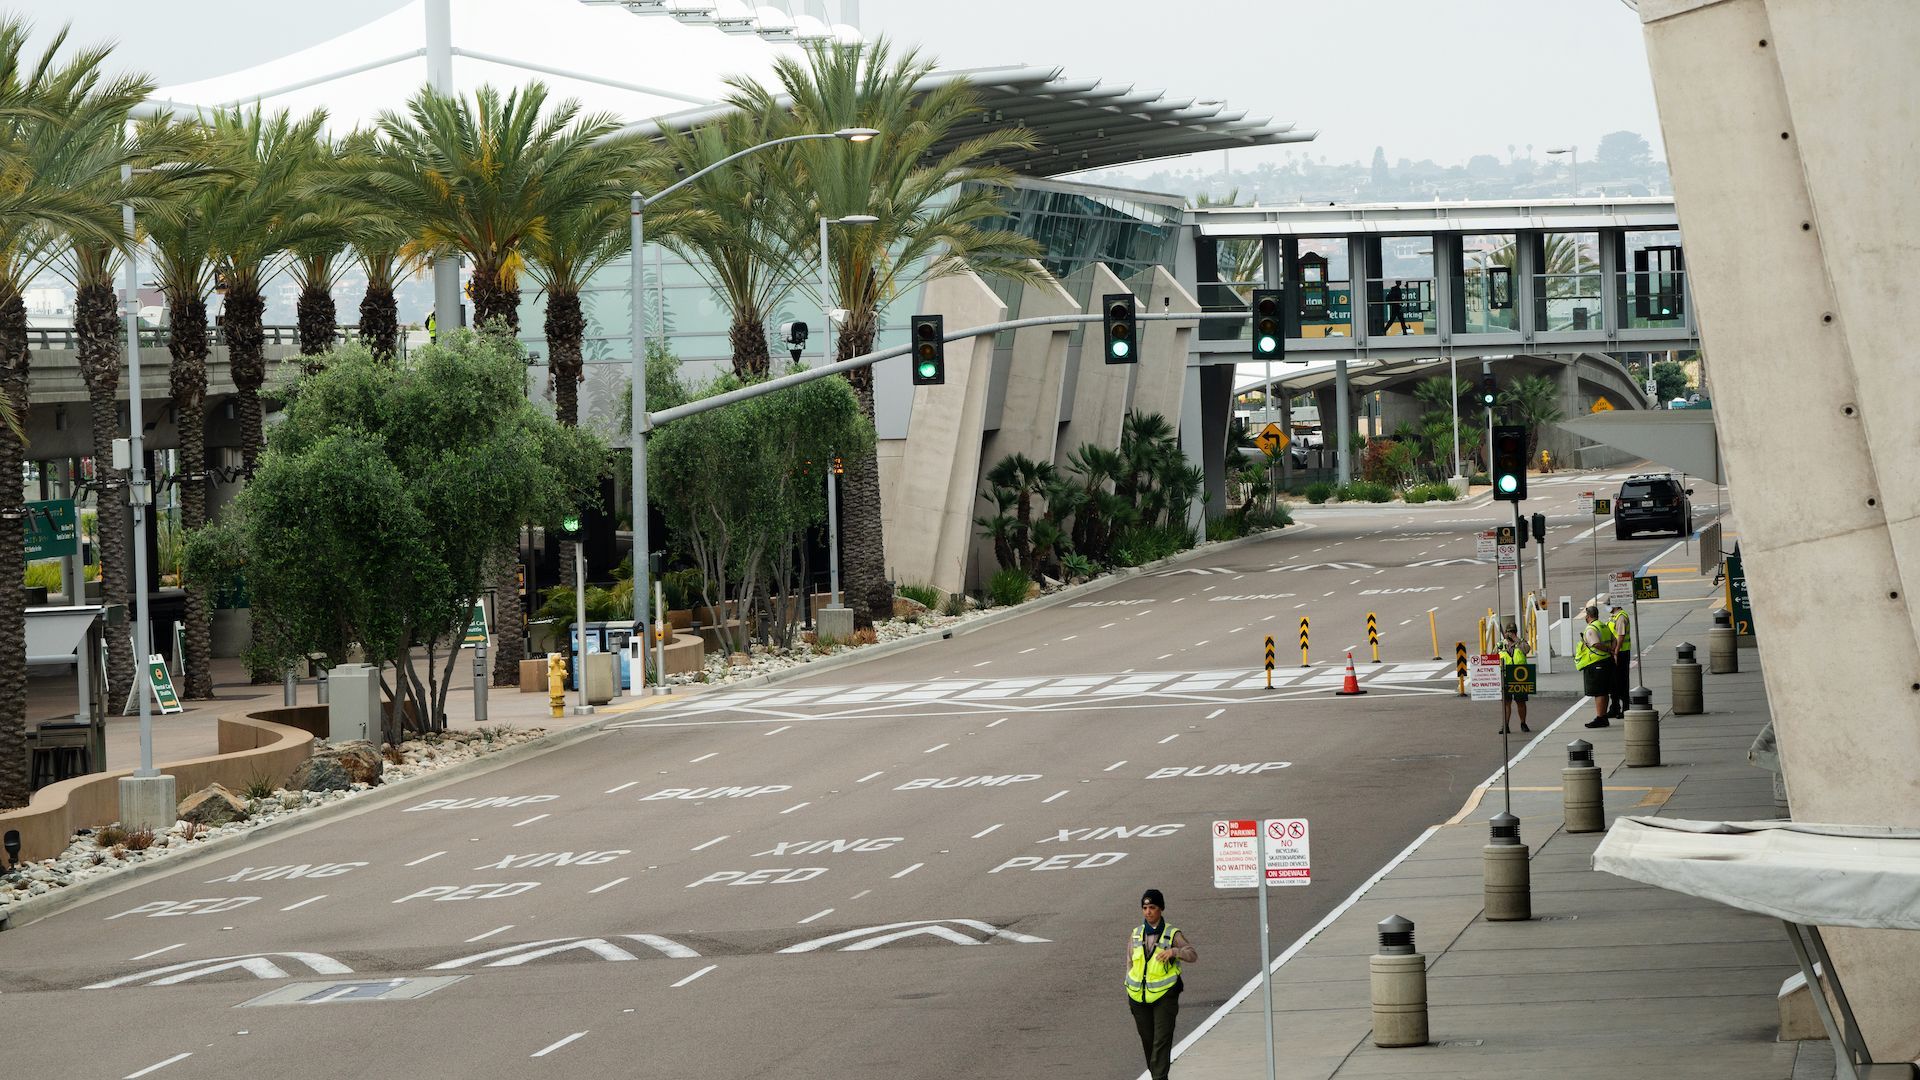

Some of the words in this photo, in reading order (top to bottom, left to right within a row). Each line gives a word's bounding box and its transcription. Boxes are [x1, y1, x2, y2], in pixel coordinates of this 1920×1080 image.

[1403, 311, 1422, 320] arking
[1502, 528, 1510, 536] Q
[1642, 578, 1651, 590] P
[1145, 762, 1292, 779] BUMP
[893, 774, 1043, 790] BUMP
[639, 786, 792, 801] BUMP
[402, 795, 560, 812] BUMP
[1036, 823, 1185, 843] XING
[751, 837, 904, 856] XING
[474, 850, 631, 870] XING
[987, 852, 1128, 873] PED
[204, 862, 369, 883] XING
[685, 868, 829, 888] PED
[392, 882, 541, 903] PED
[104, 896, 262, 920] PED
